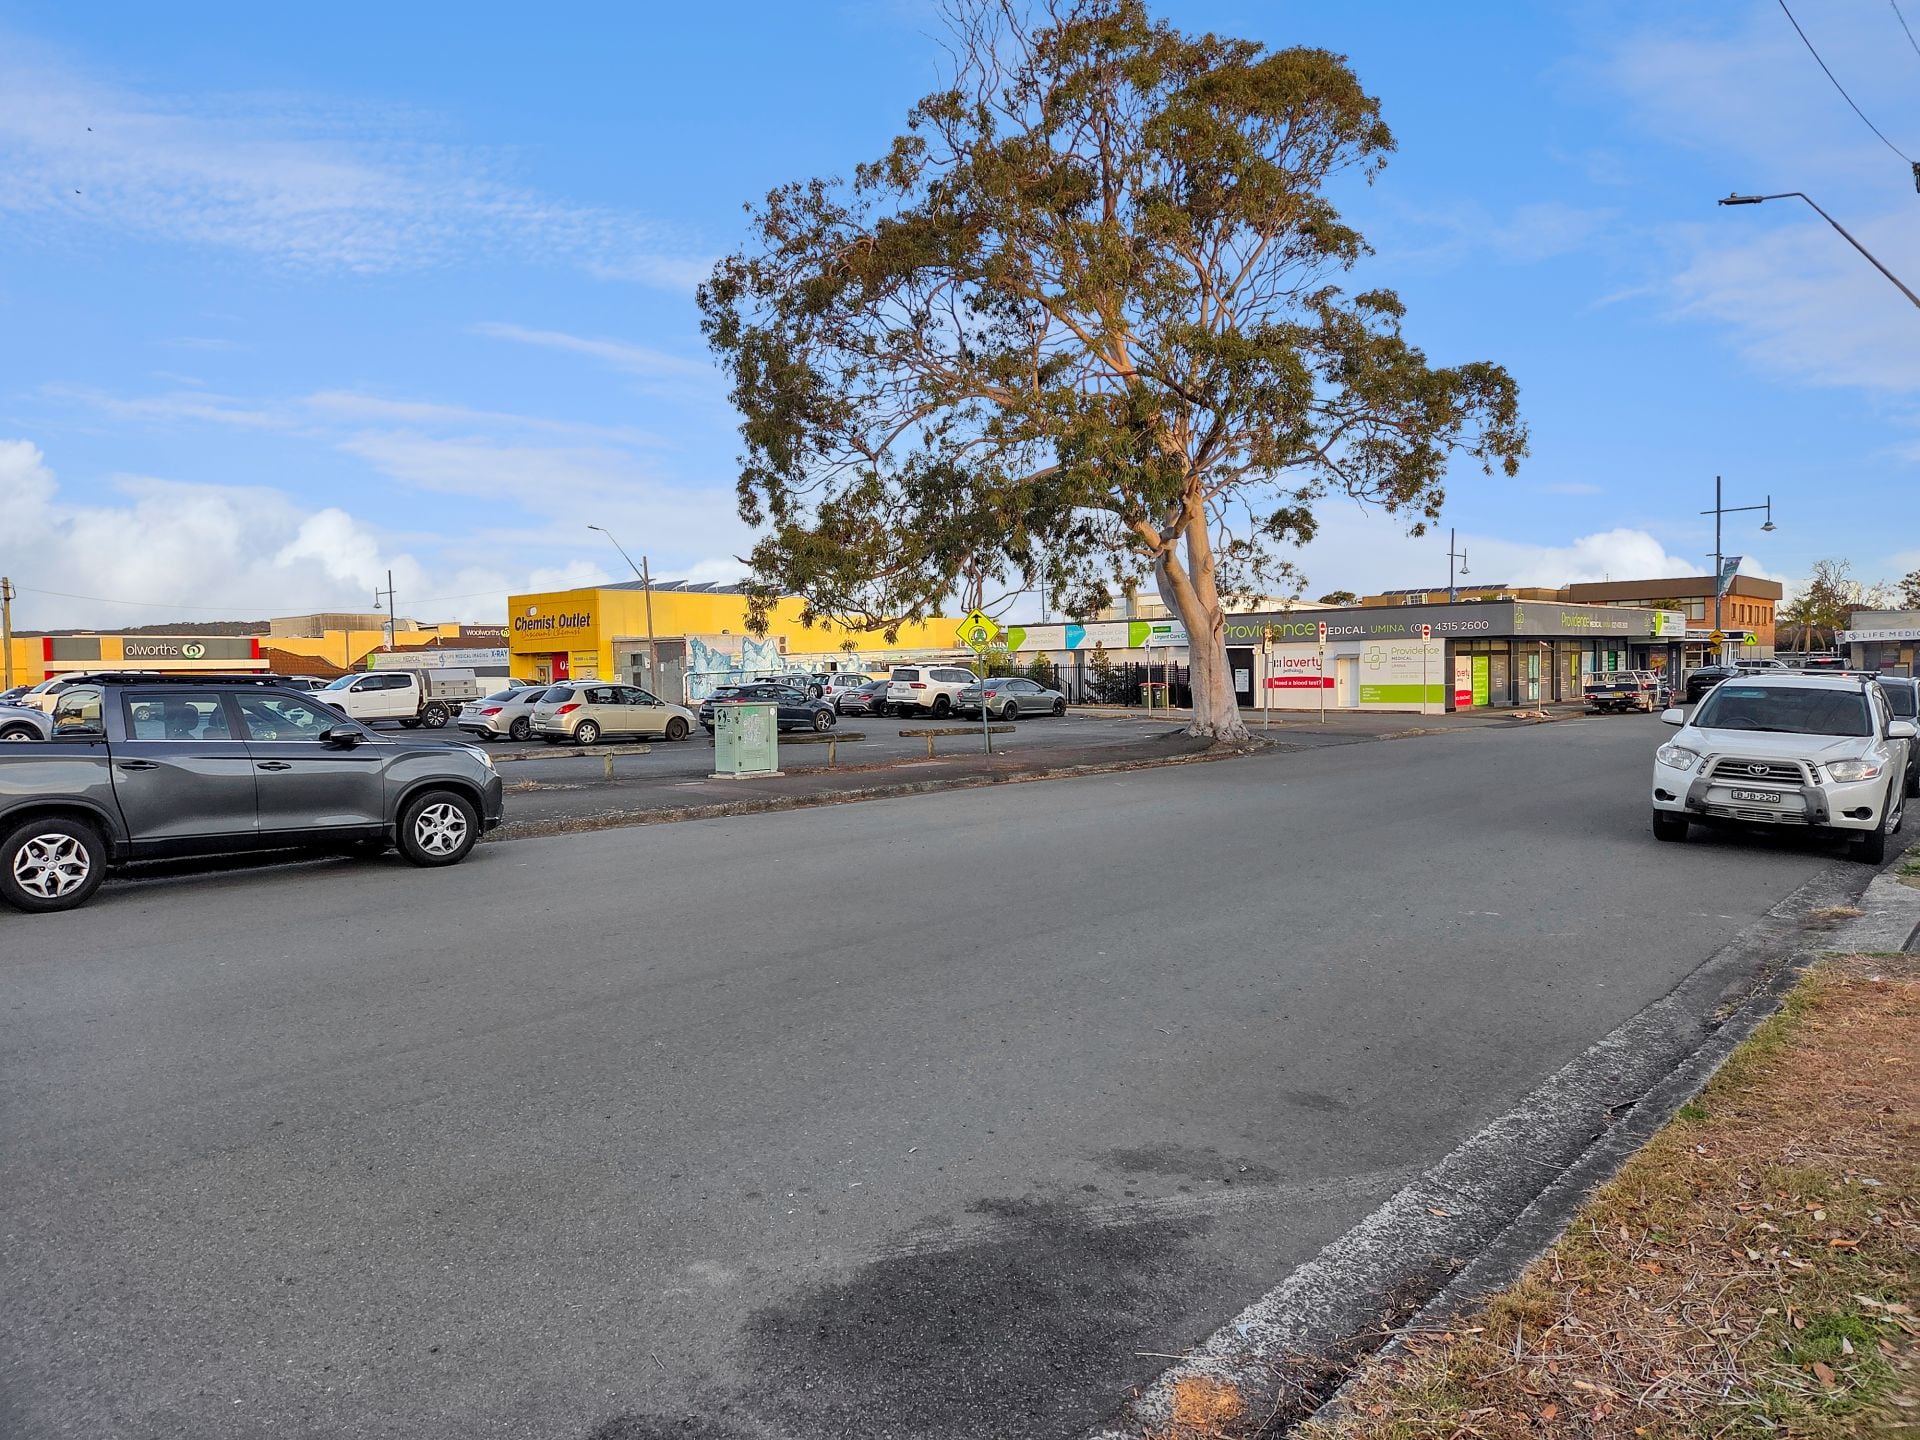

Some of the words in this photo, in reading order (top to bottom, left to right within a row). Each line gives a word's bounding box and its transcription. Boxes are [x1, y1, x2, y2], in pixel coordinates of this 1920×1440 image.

[514, 615, 555, 631] Chemist
[558, 612, 591, 628] Outlet
[466, 629, 500, 637] Woolworths
[1328, 625, 1366, 635] EDICAL
[1370, 623, 1405, 634] UMINA
[1434, 621, 1458, 631] 4315
[1461, 620, 1489, 631] 2600
[1862, 631, 1885, 639] LIFE
[126, 643, 178, 656] olworths
[491, 649, 508, 658] X-RAY
[1391, 646, 1440, 656] Providence
[1283, 656, 1322, 671] laverty
